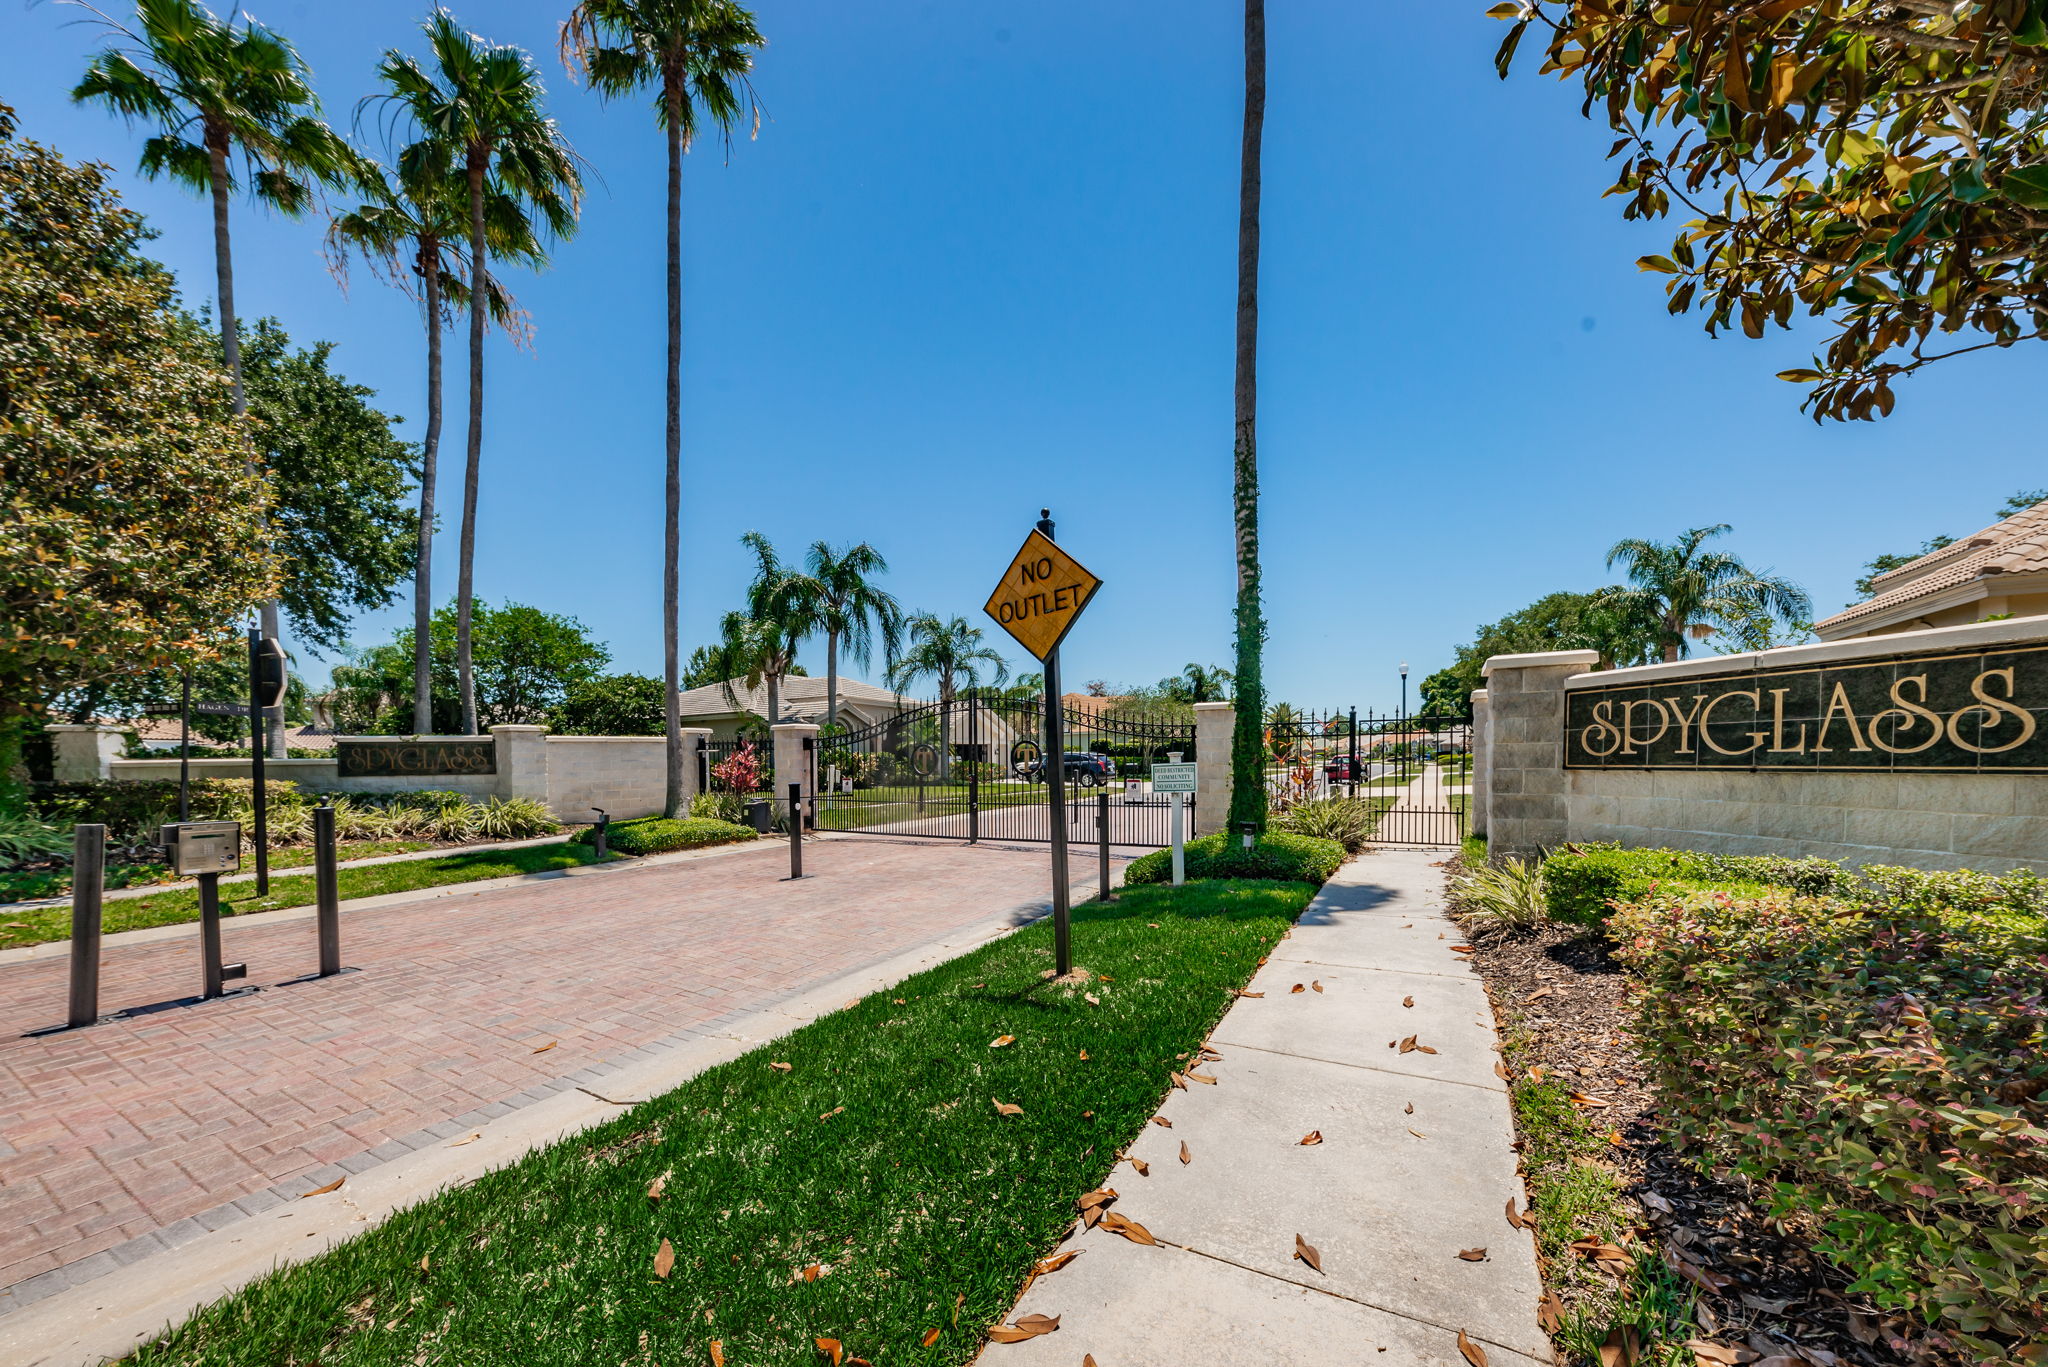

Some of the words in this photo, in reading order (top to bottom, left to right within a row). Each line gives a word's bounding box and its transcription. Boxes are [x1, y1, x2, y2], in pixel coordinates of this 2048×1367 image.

[1021, 558, 1052, 585] NO
[999, 584, 1081, 624] OUTLET
[1581, 667, 2037, 757] SPYGLASS
[347, 747, 488, 770] SPYGLASS
